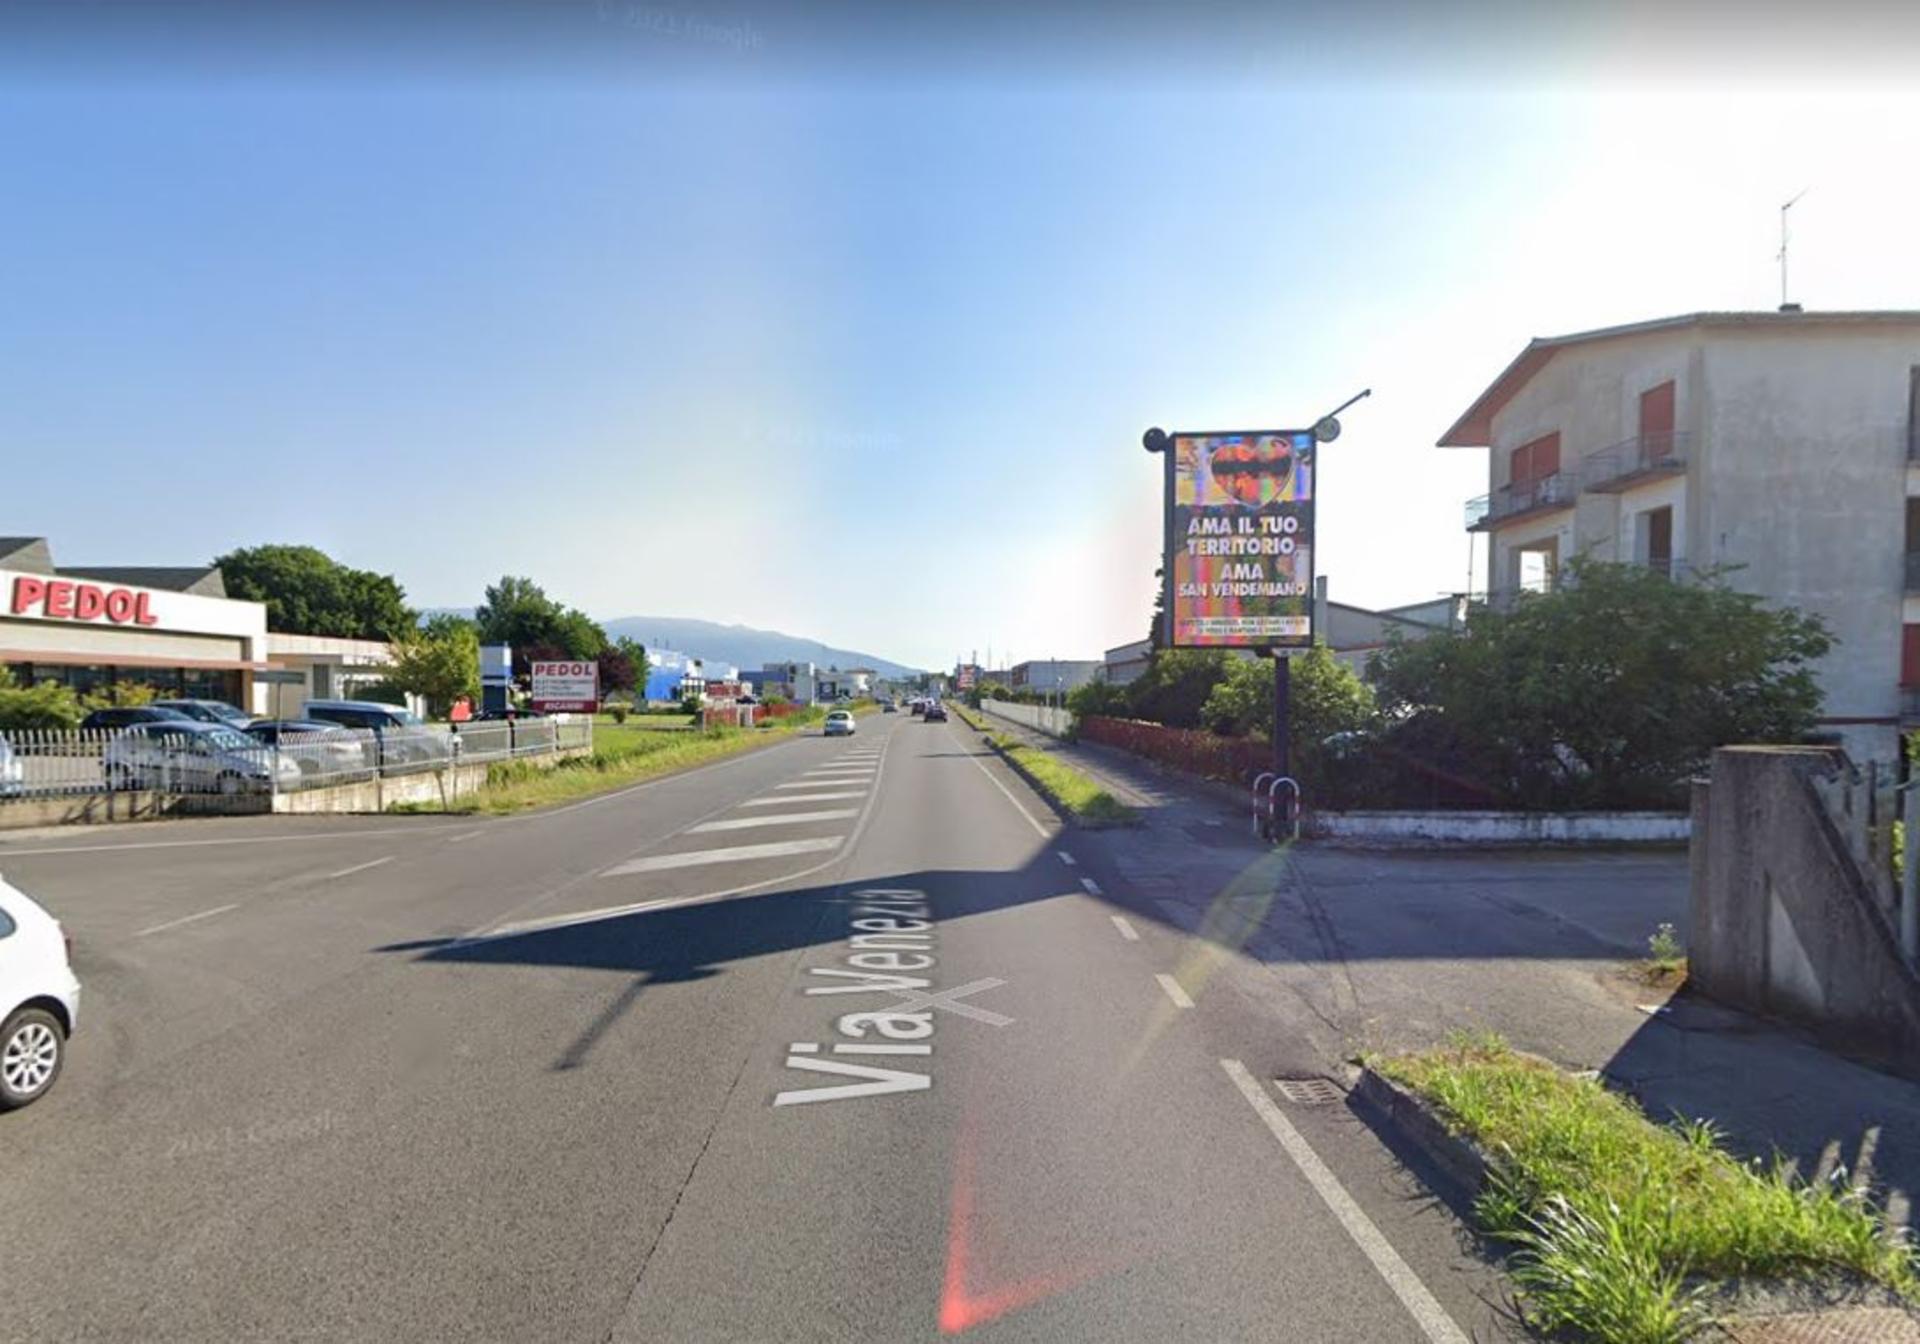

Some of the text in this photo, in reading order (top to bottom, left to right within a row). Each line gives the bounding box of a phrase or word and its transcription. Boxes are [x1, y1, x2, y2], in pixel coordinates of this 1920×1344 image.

[1188, 516, 1298, 534] AMA IL TUO
[1188, 538, 1294, 555] TERRITORIO
[1221, 563, 1264, 580] AMA
[1178, 582, 1307, 597] SAN VENDEMIANO
[12, 577, 158, 625] PEDOL
[535, 663, 593, 676] PEDOL
